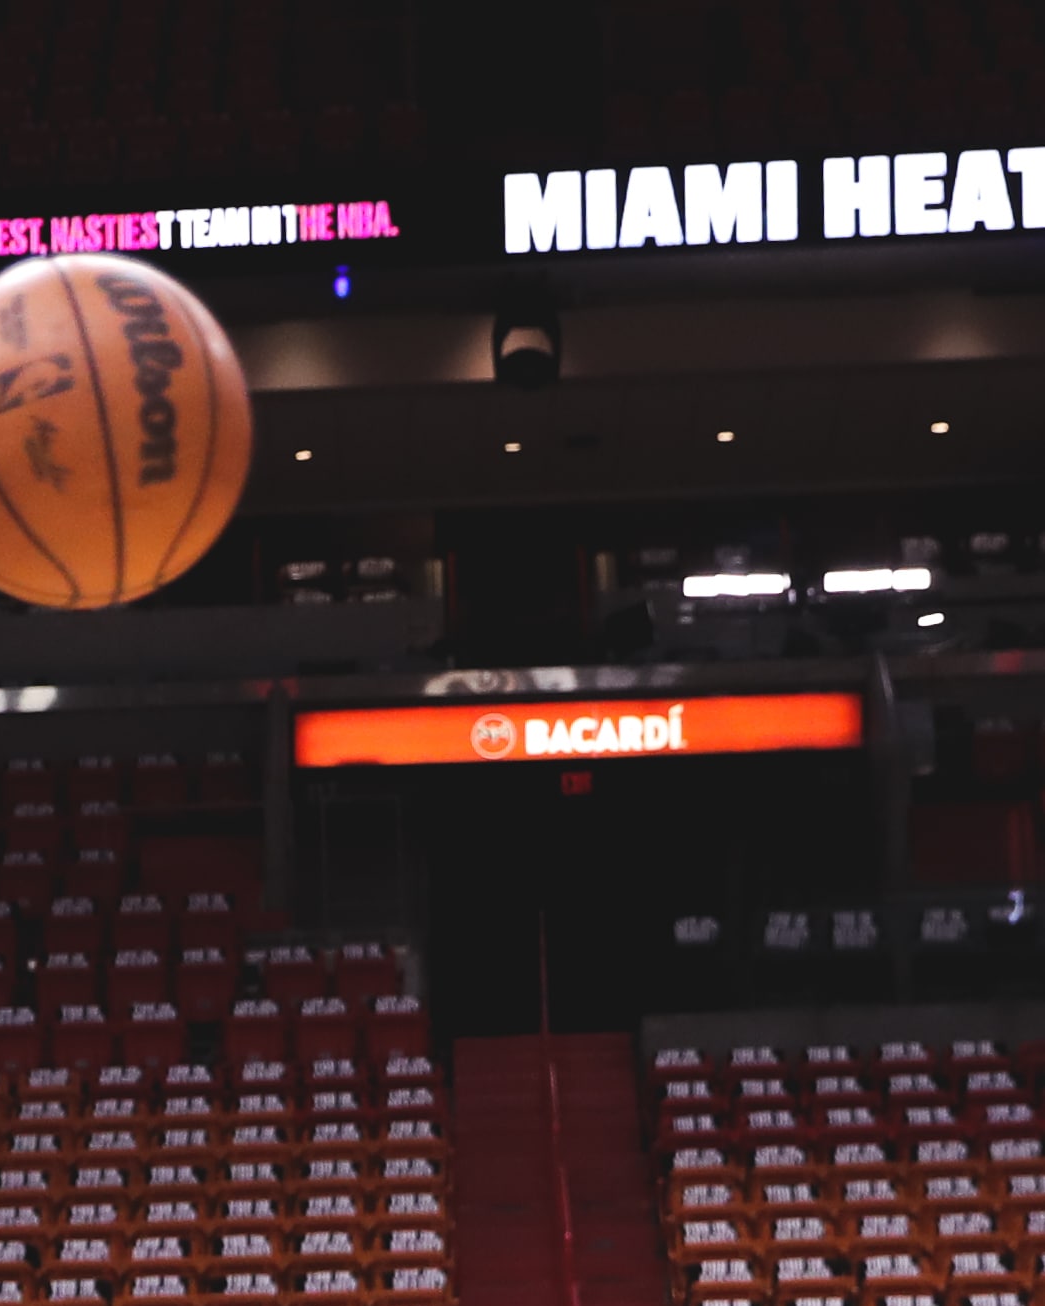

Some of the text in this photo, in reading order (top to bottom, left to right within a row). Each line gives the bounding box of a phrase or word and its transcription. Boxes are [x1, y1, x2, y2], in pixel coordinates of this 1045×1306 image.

[504, 147, 1045, 254] MIAMI HEAT
[176, 206, 250, 248] TEAM
[525, 704, 684, 756] BACARDÍ
